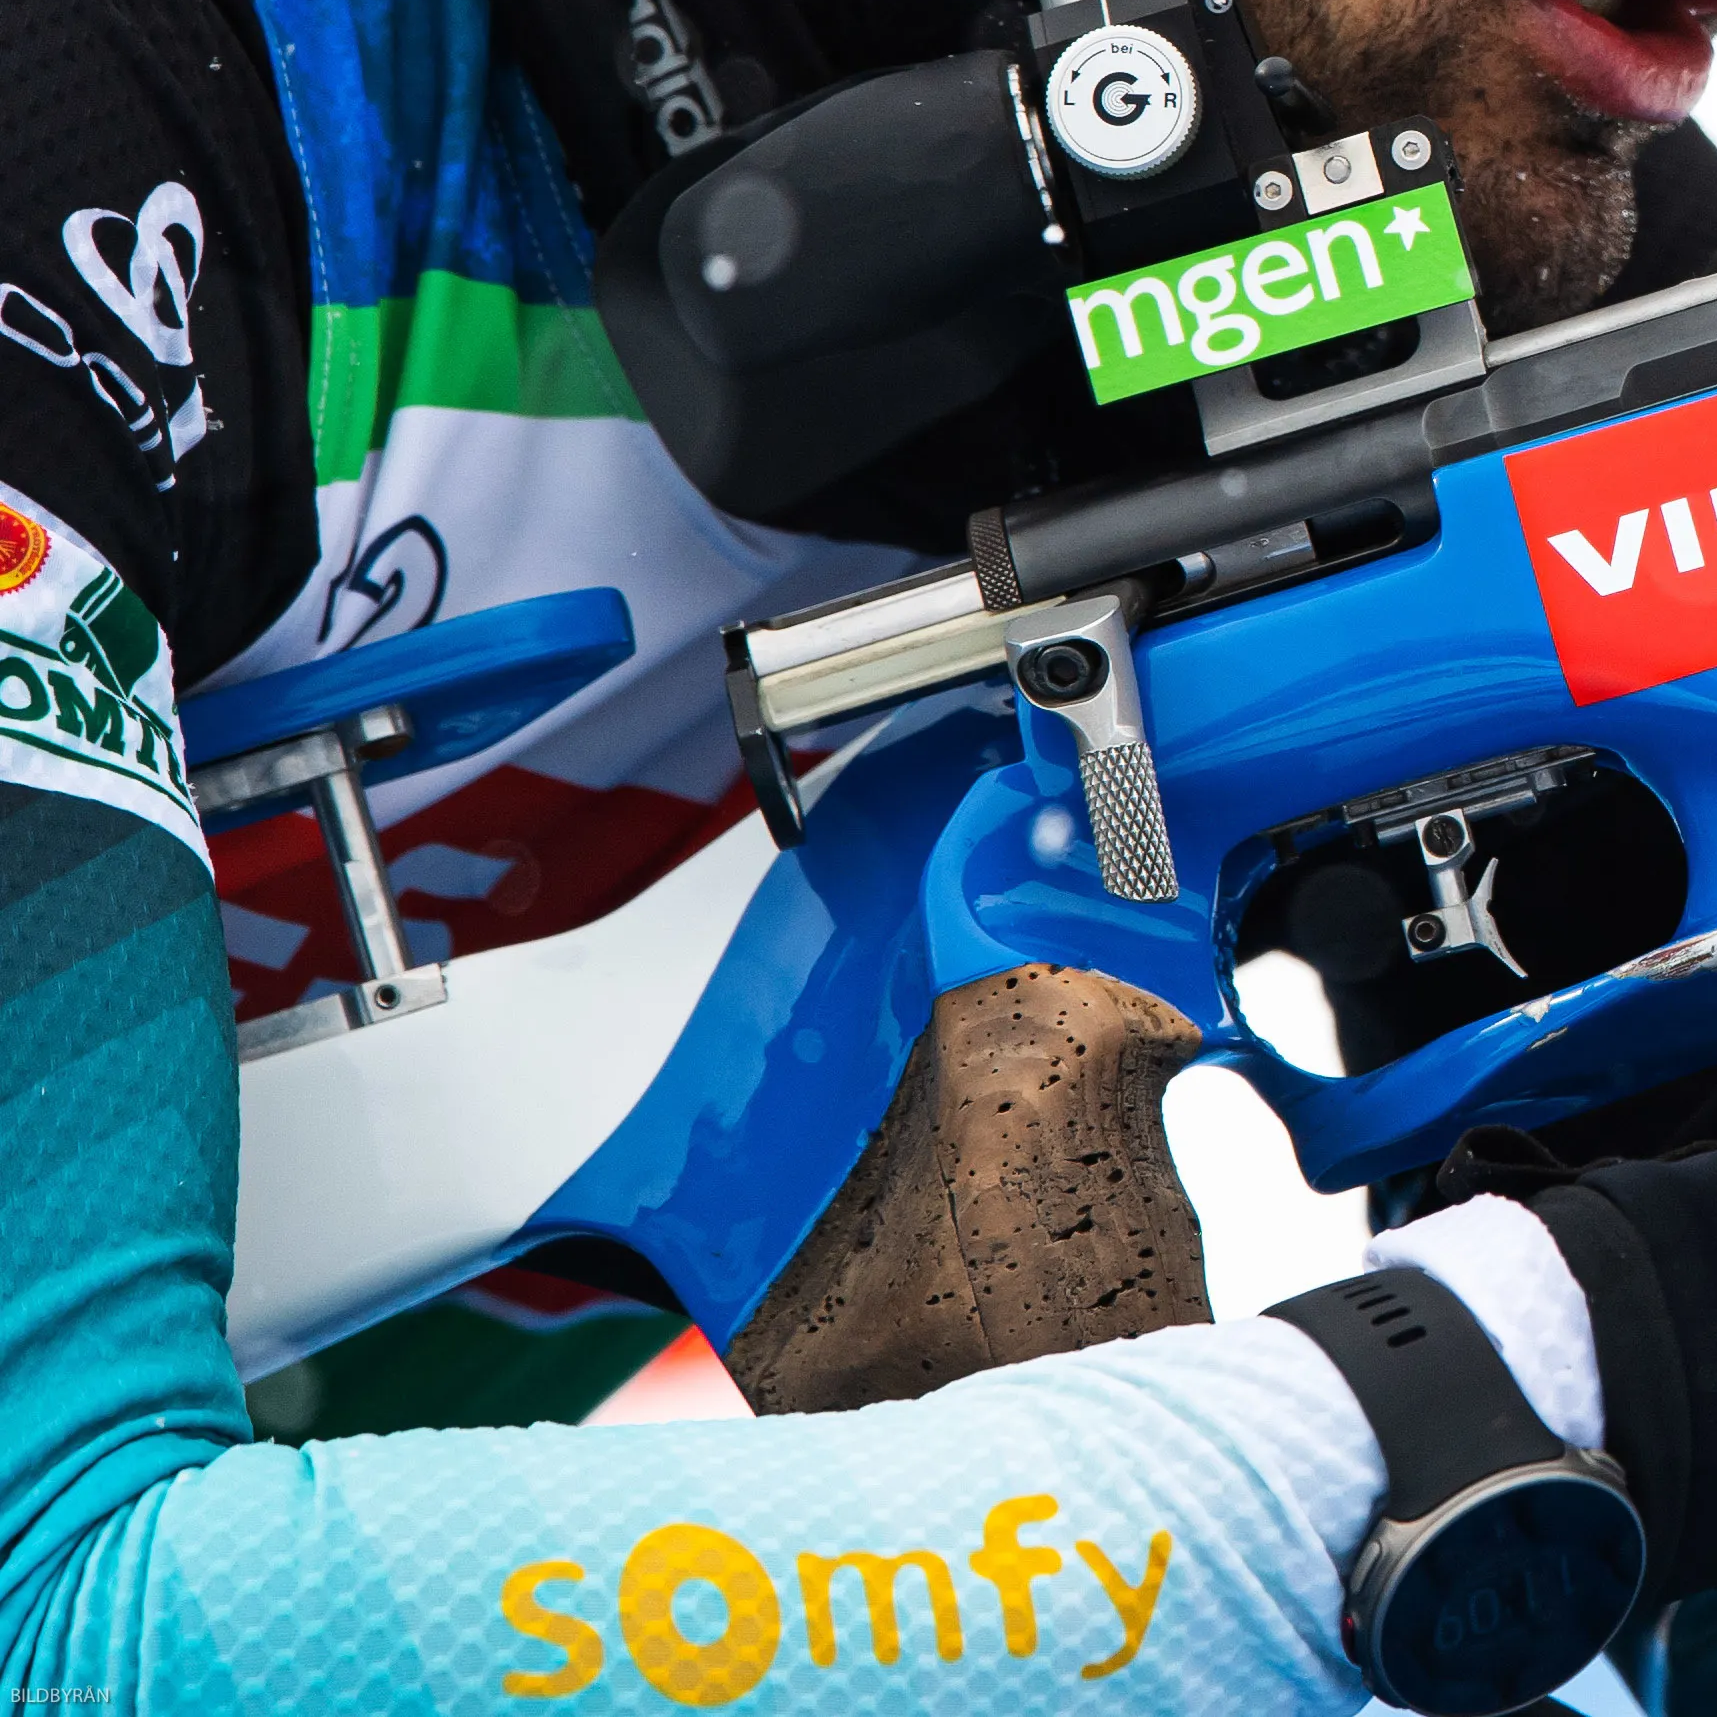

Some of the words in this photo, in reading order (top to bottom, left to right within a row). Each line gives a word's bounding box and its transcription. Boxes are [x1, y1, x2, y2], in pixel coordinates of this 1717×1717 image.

[1110, 43, 1133, 54] bei
[1064, 90, 1075, 106] L
[1164, 92, 1177, 108] R
[1071, 219, 1385, 370] mgen
[500, 1493, 1173, 1707] somfy
